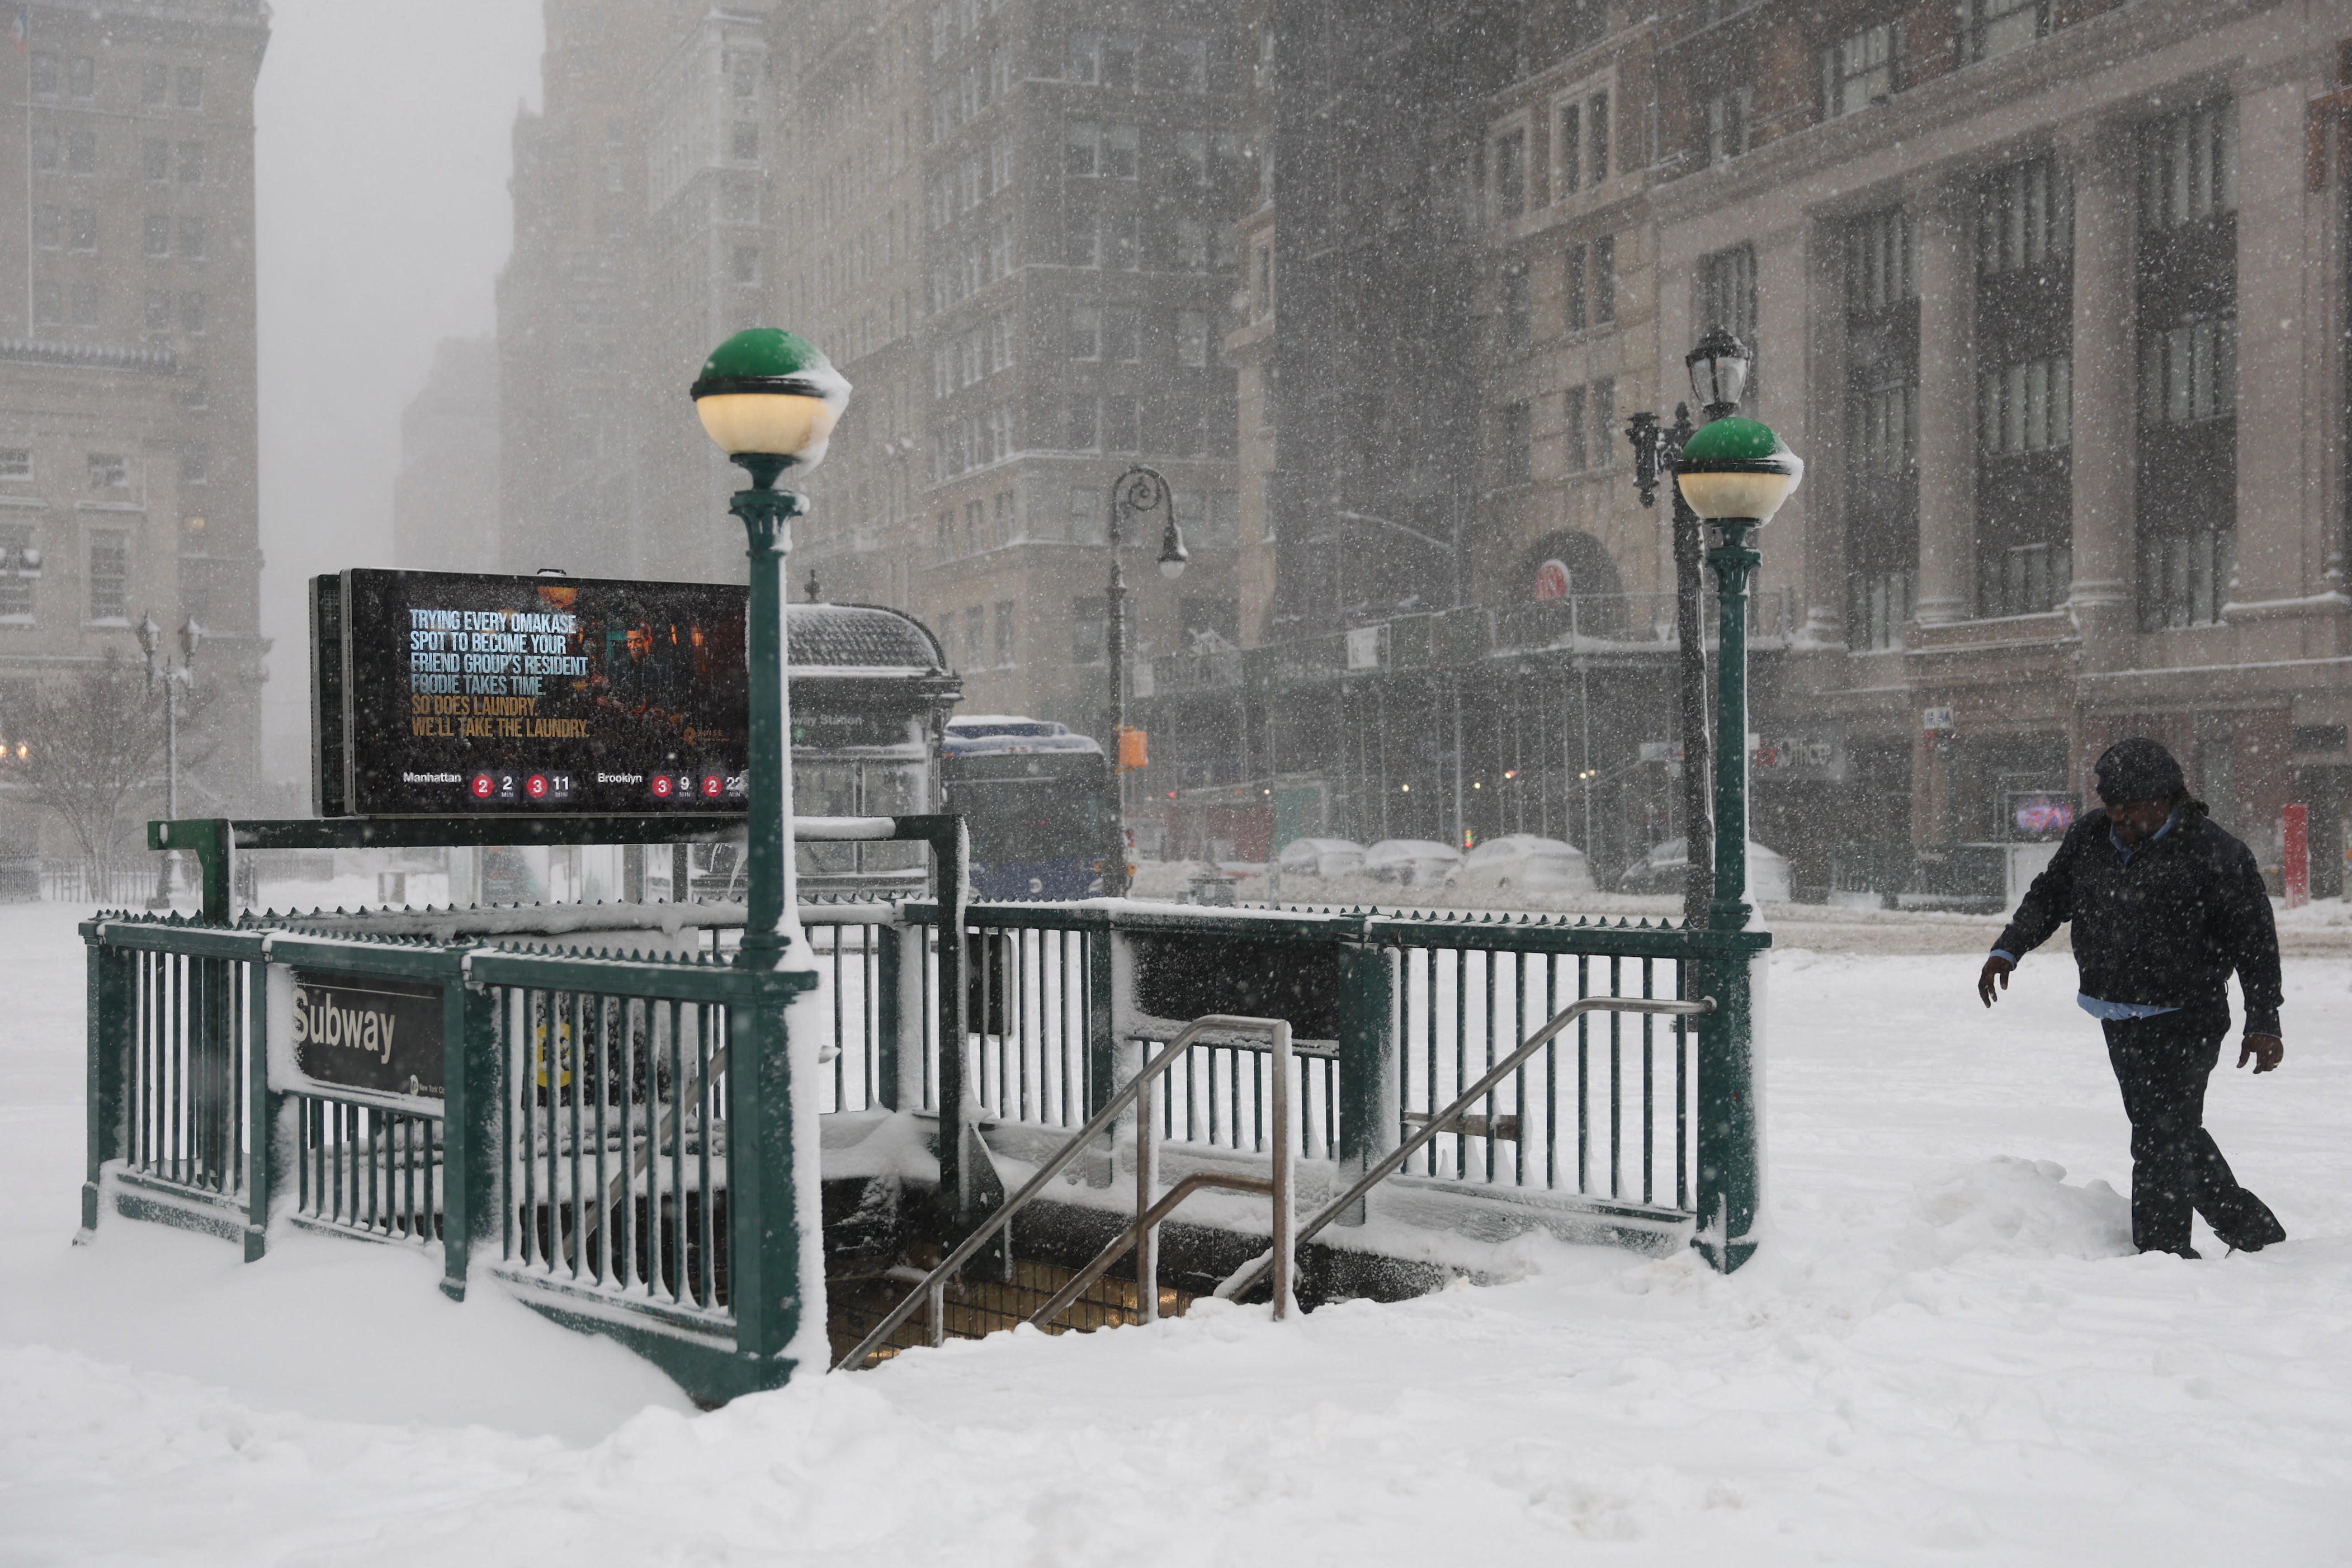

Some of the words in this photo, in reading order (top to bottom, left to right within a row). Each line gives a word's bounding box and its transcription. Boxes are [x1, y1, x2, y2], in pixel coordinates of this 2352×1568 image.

[410, 610, 460, 630] TRYING
[464, 611, 508, 631] EVERY
[512, 613, 577, 634] OMAKASE
[410, 631, 446, 650] SPOT
[452, 632, 469, 651] TO
[472, 632, 527, 653] BECOME
[531, 635, 566, 654] YOUR
[411, 653, 460, 673] FRIEND
[464, 653, 521, 674] GROUP'S
[525, 656, 588, 676] RESIDENT
[412, 674, 460, 693] FOODIE
[463, 675, 507, 695] TAKES
[511, 676, 546, 695] TIME.
[412, 696, 430, 715] SO
[434, 696, 470, 715] DOES
[474, 697, 538, 716] LAUNDRY.
[412, 717, 455, 736] WE'LL
[458, 717, 493, 736] TAKE
[497, 717, 523, 737] THE
[526, 718, 589, 738] LAUNDRY.
[819, 714, 862, 725] Station
[403, 772, 461, 782] Manhattan
[478, 780, 488, 792] 2
[503, 776, 512, 790] 2
[533, 780, 542, 793] 3
[552, 776, 569, 790] 11
[597, 773, 643, 785] Brooklyn
[658, 780, 667, 792] 3
[681, 776, 689, 790] 9
[709, 780, 717, 792] 2
[294, 986, 396, 1064] Subway
[428, 1084, 438, 1093] York
